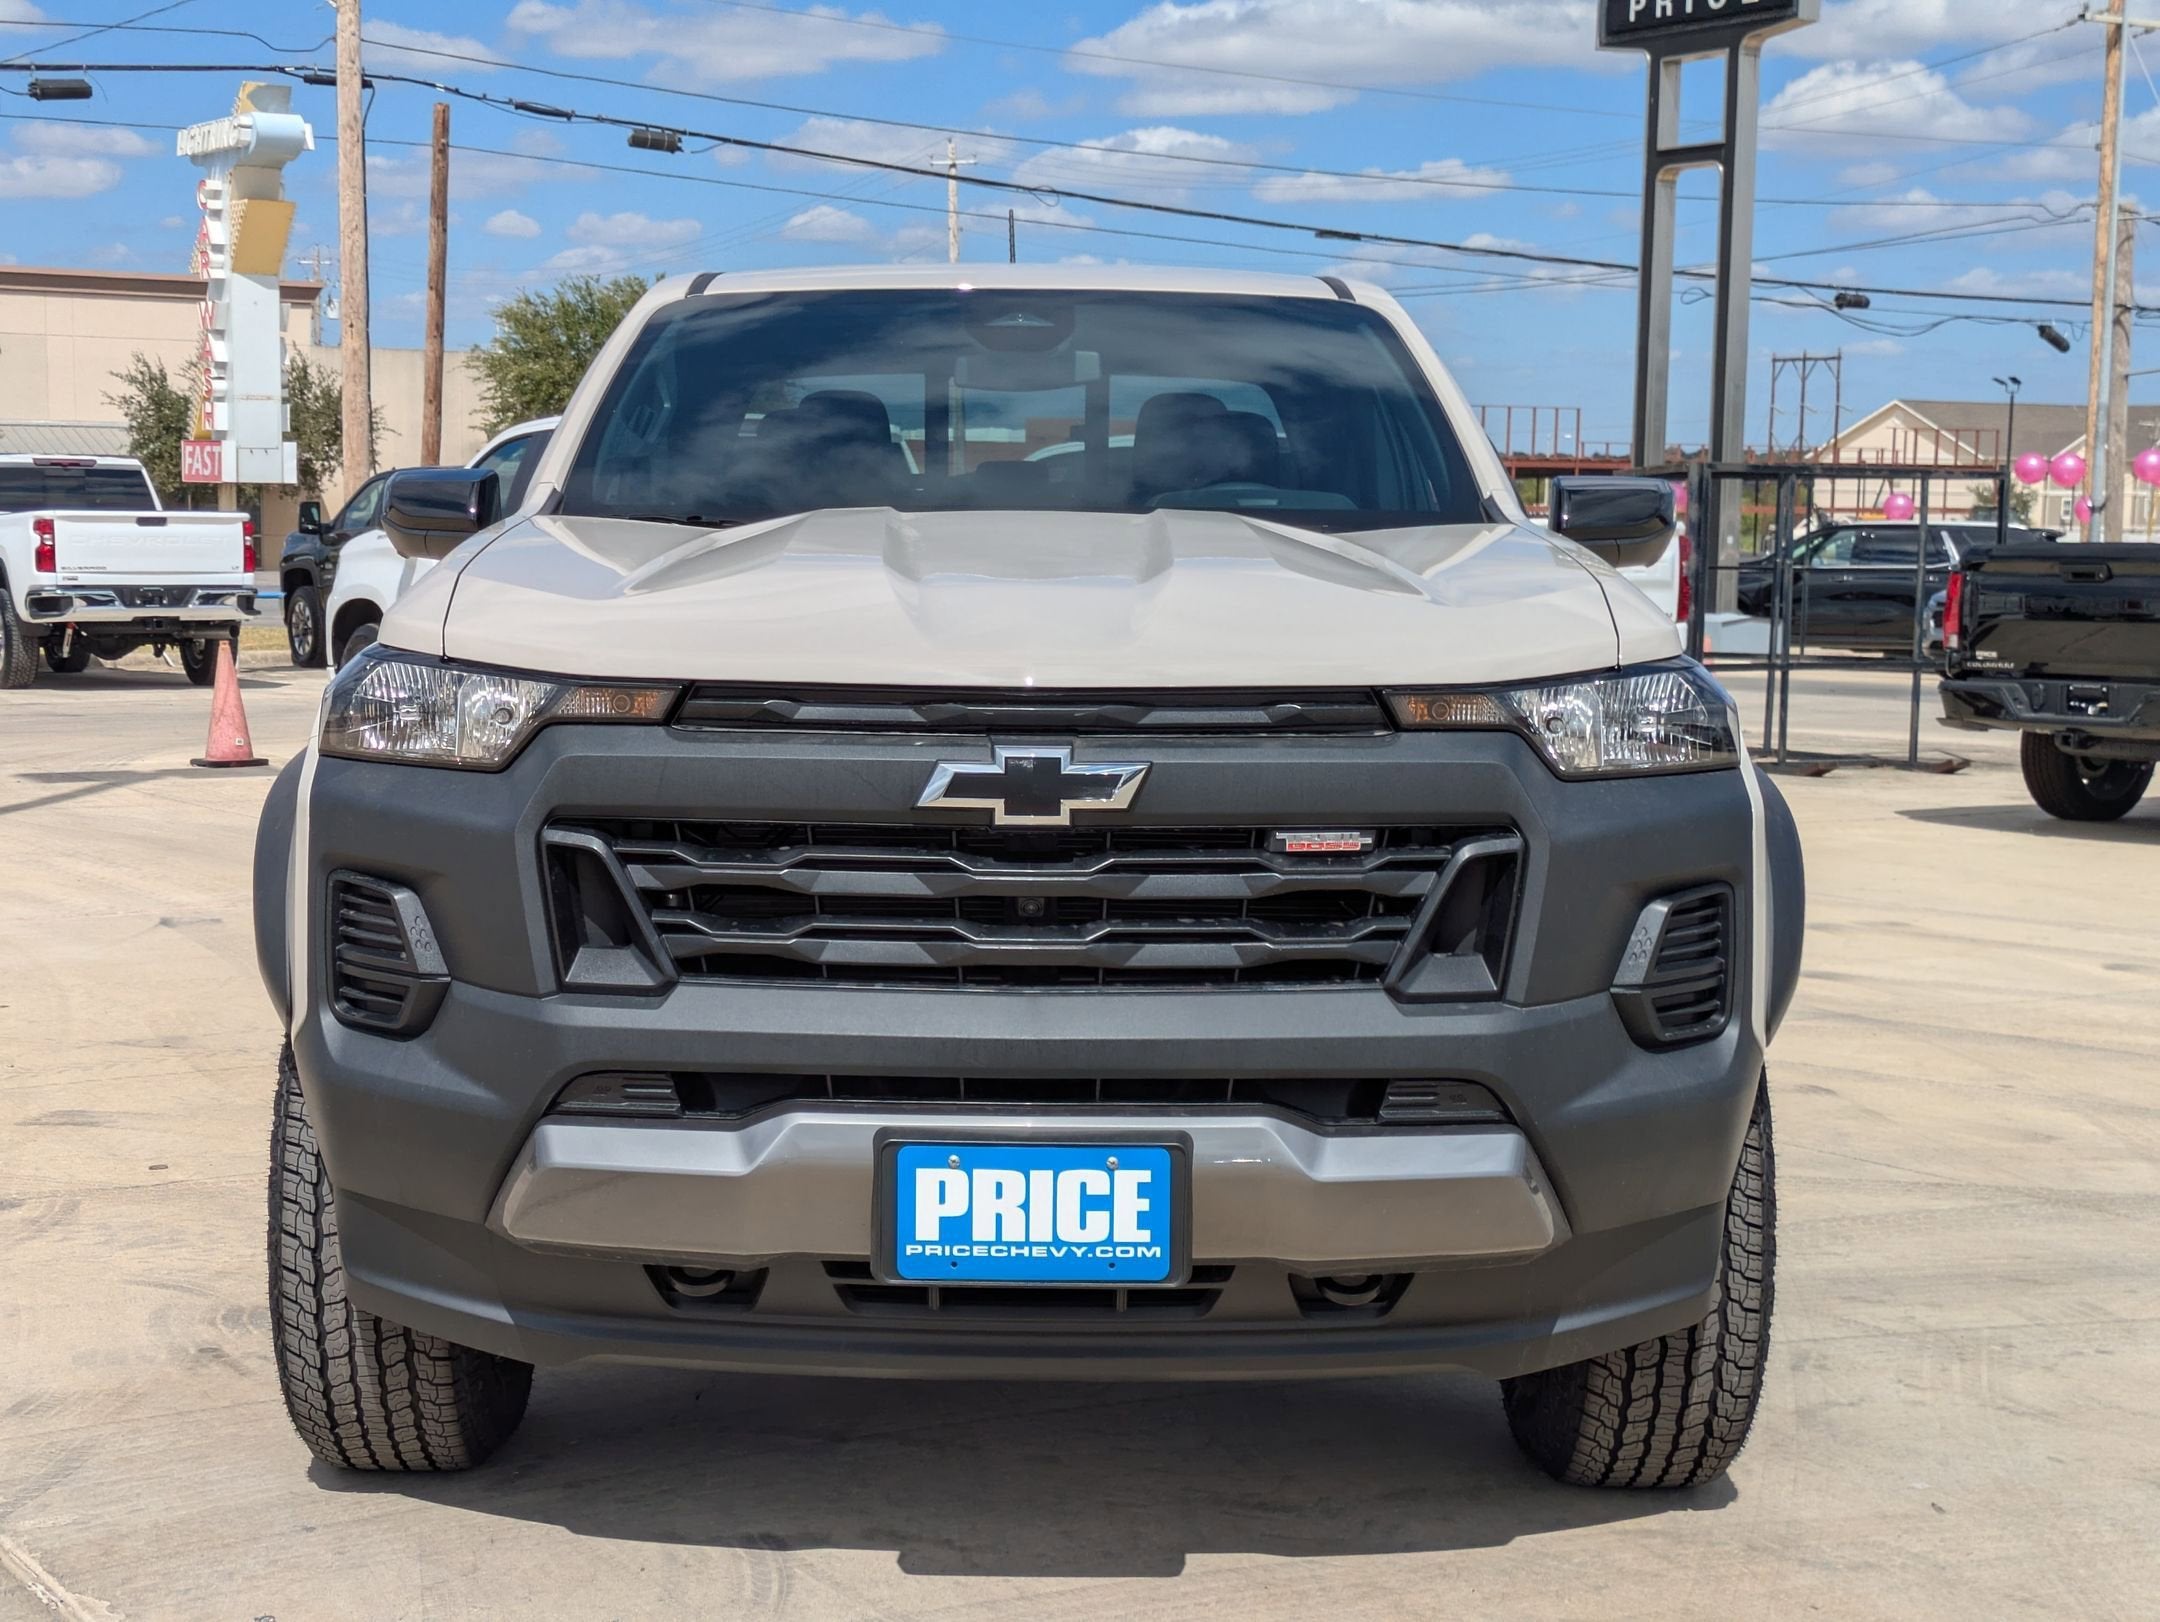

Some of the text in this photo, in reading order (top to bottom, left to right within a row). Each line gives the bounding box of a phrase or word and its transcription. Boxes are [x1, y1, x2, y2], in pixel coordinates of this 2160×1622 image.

[1629, 0, 1759, 22] PRI
[184, 445, 222, 476] FAST
[915, 1168, 1152, 1243] PRICE
[905, 1244, 1161, 1258] PRICECHEVY.COM
